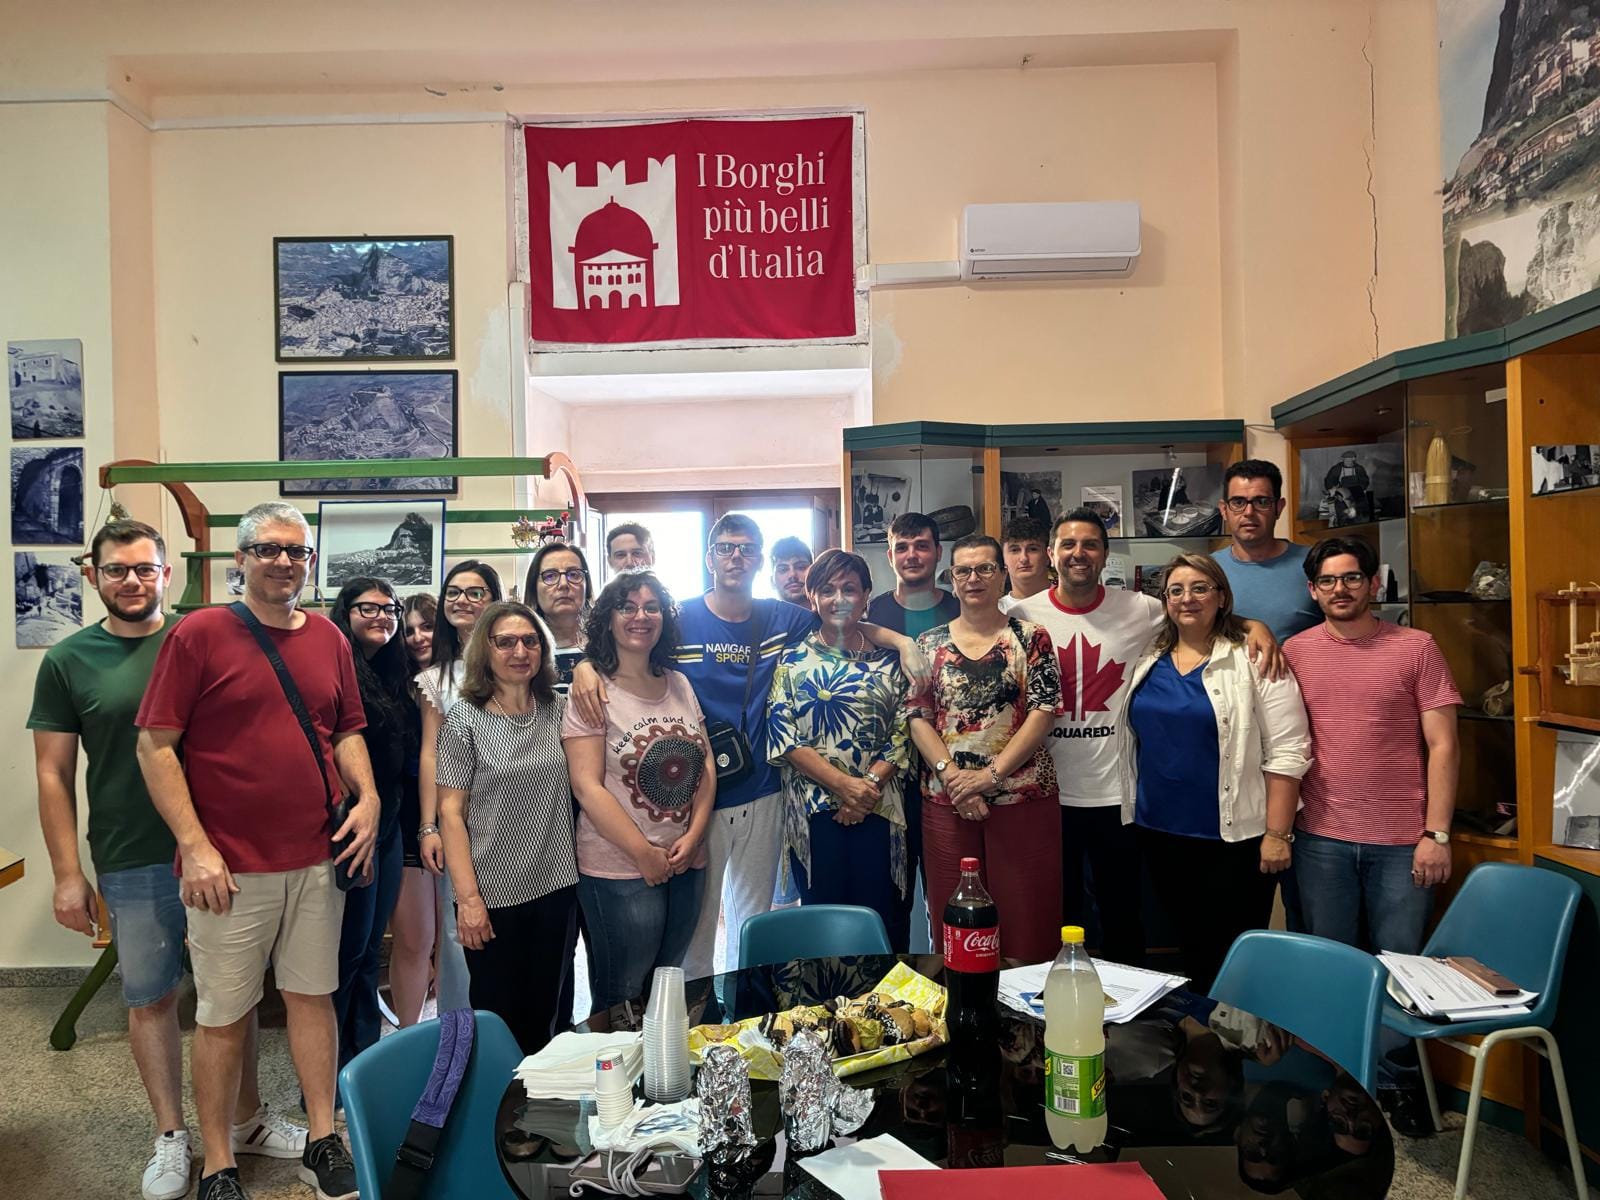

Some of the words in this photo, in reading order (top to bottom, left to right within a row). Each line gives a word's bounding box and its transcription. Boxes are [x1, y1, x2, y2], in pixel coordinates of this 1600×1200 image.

[697, 153, 707, 187] I
[715, 151, 826, 196] Borghi
[703, 197, 754, 241] più
[758, 196, 831, 234] belli
[708, 244, 825, 279] d'Italia
[612, 731, 633, 755] keep
[633, 715, 658, 731] calm
[662, 716, 685, 725] and
